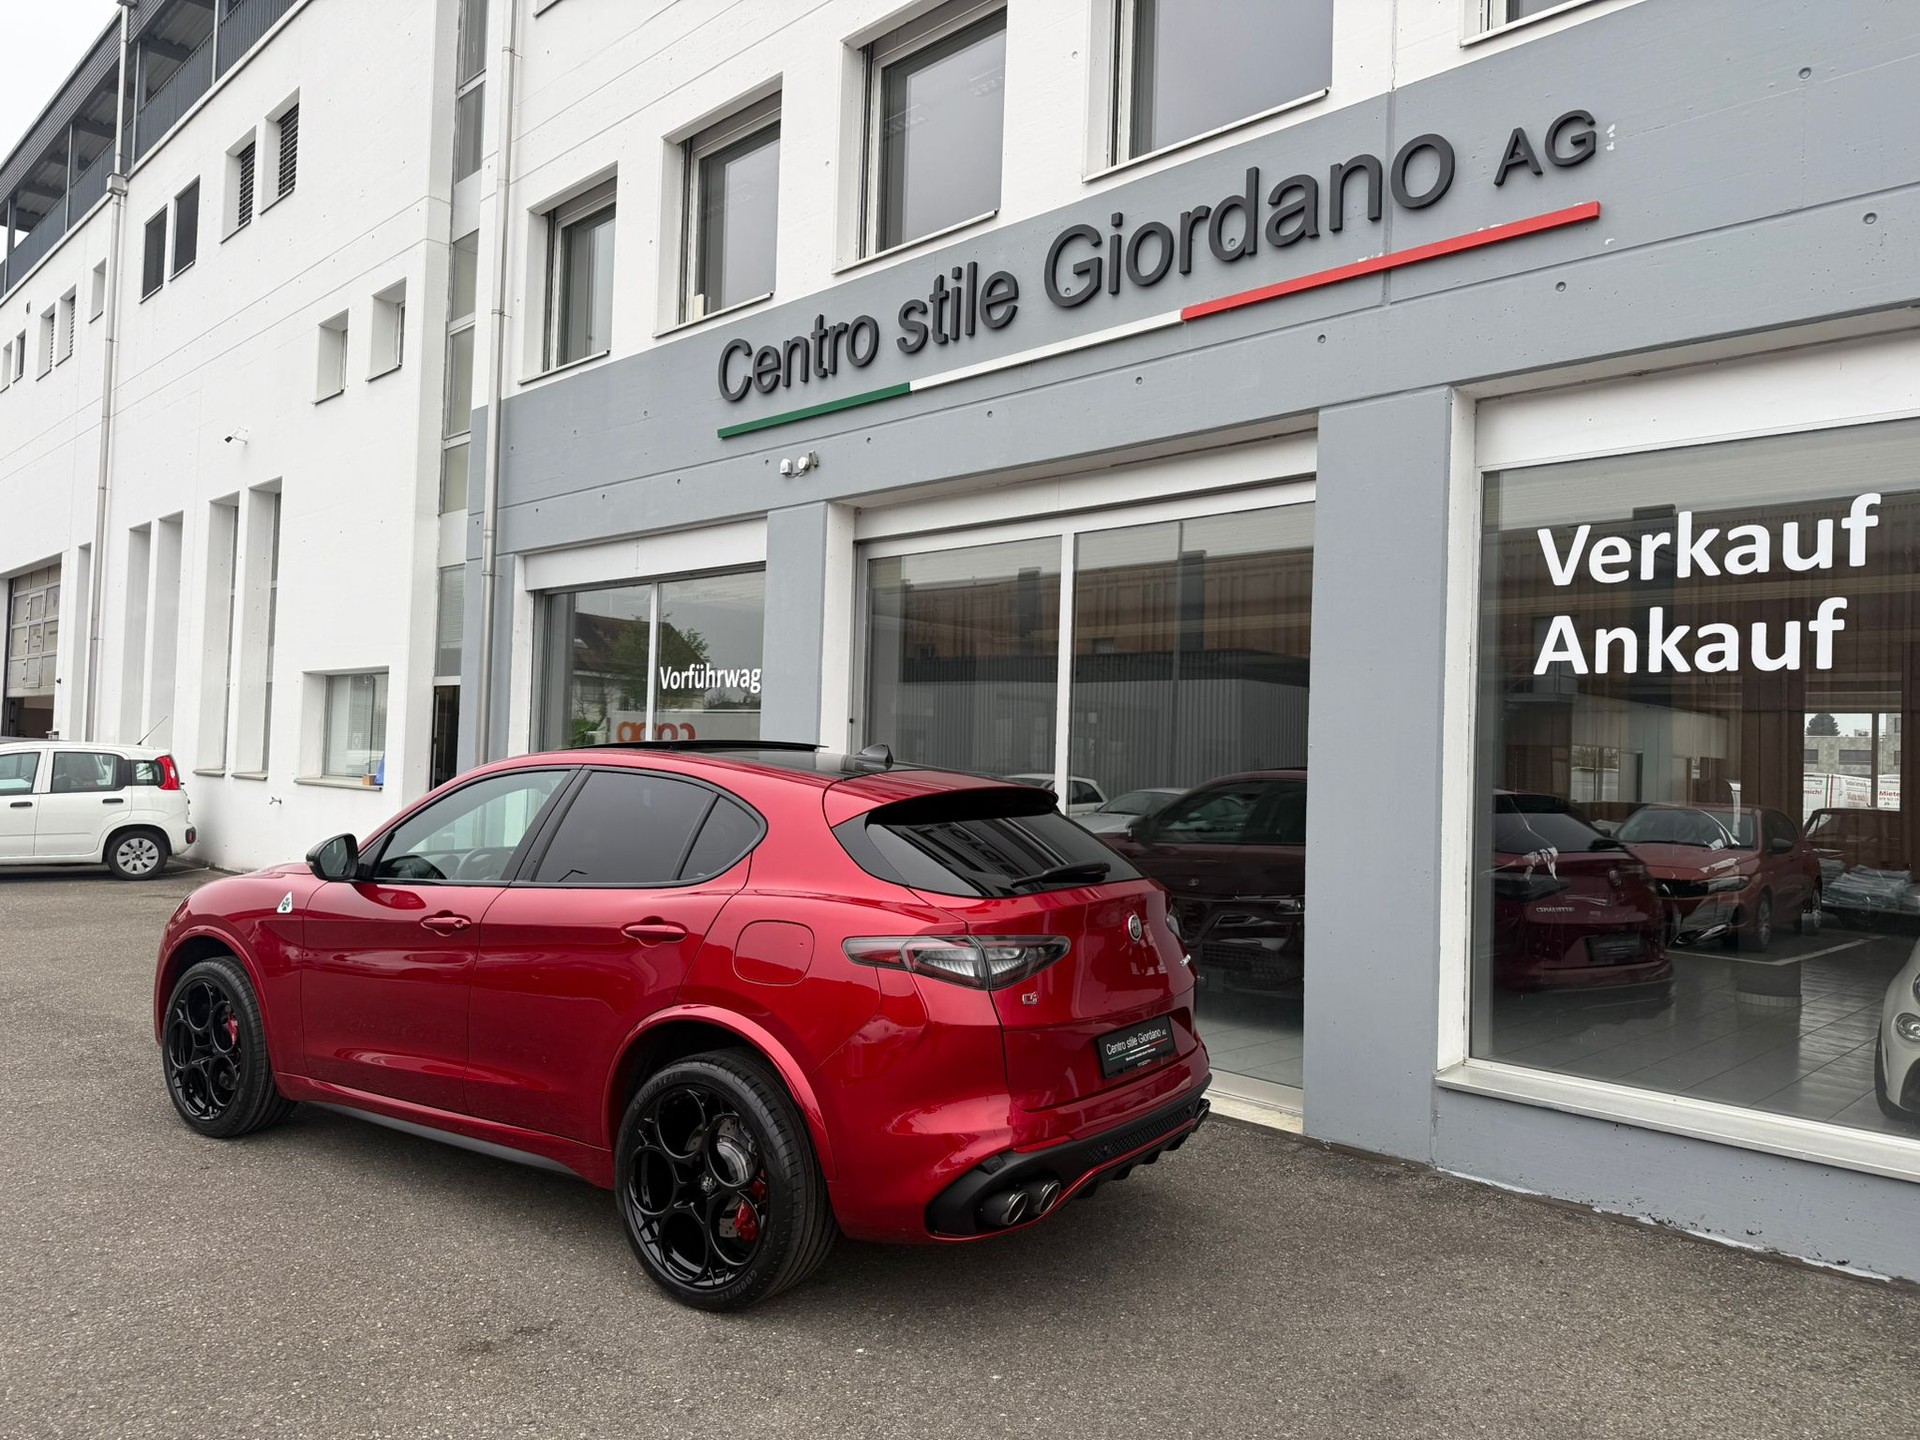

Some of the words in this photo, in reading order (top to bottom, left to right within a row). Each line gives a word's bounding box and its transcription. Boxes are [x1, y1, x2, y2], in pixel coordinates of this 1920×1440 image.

[717, 314, 880, 402] Centro
[896, 261, 1019, 355] stile
[1044, 133, 1456, 307] Giordano
[1493, 109, 1598, 187] AG
[1536, 492, 1882, 586] Verkauf
[1533, 597, 1848, 675] Ankauf
[659, 662, 762, 694] Vorführwag
[1106, 1040, 1126, 1055] Centro
[1126, 1036, 1138, 1048] stile
[1138, 1029, 1161, 1044] Giordano
